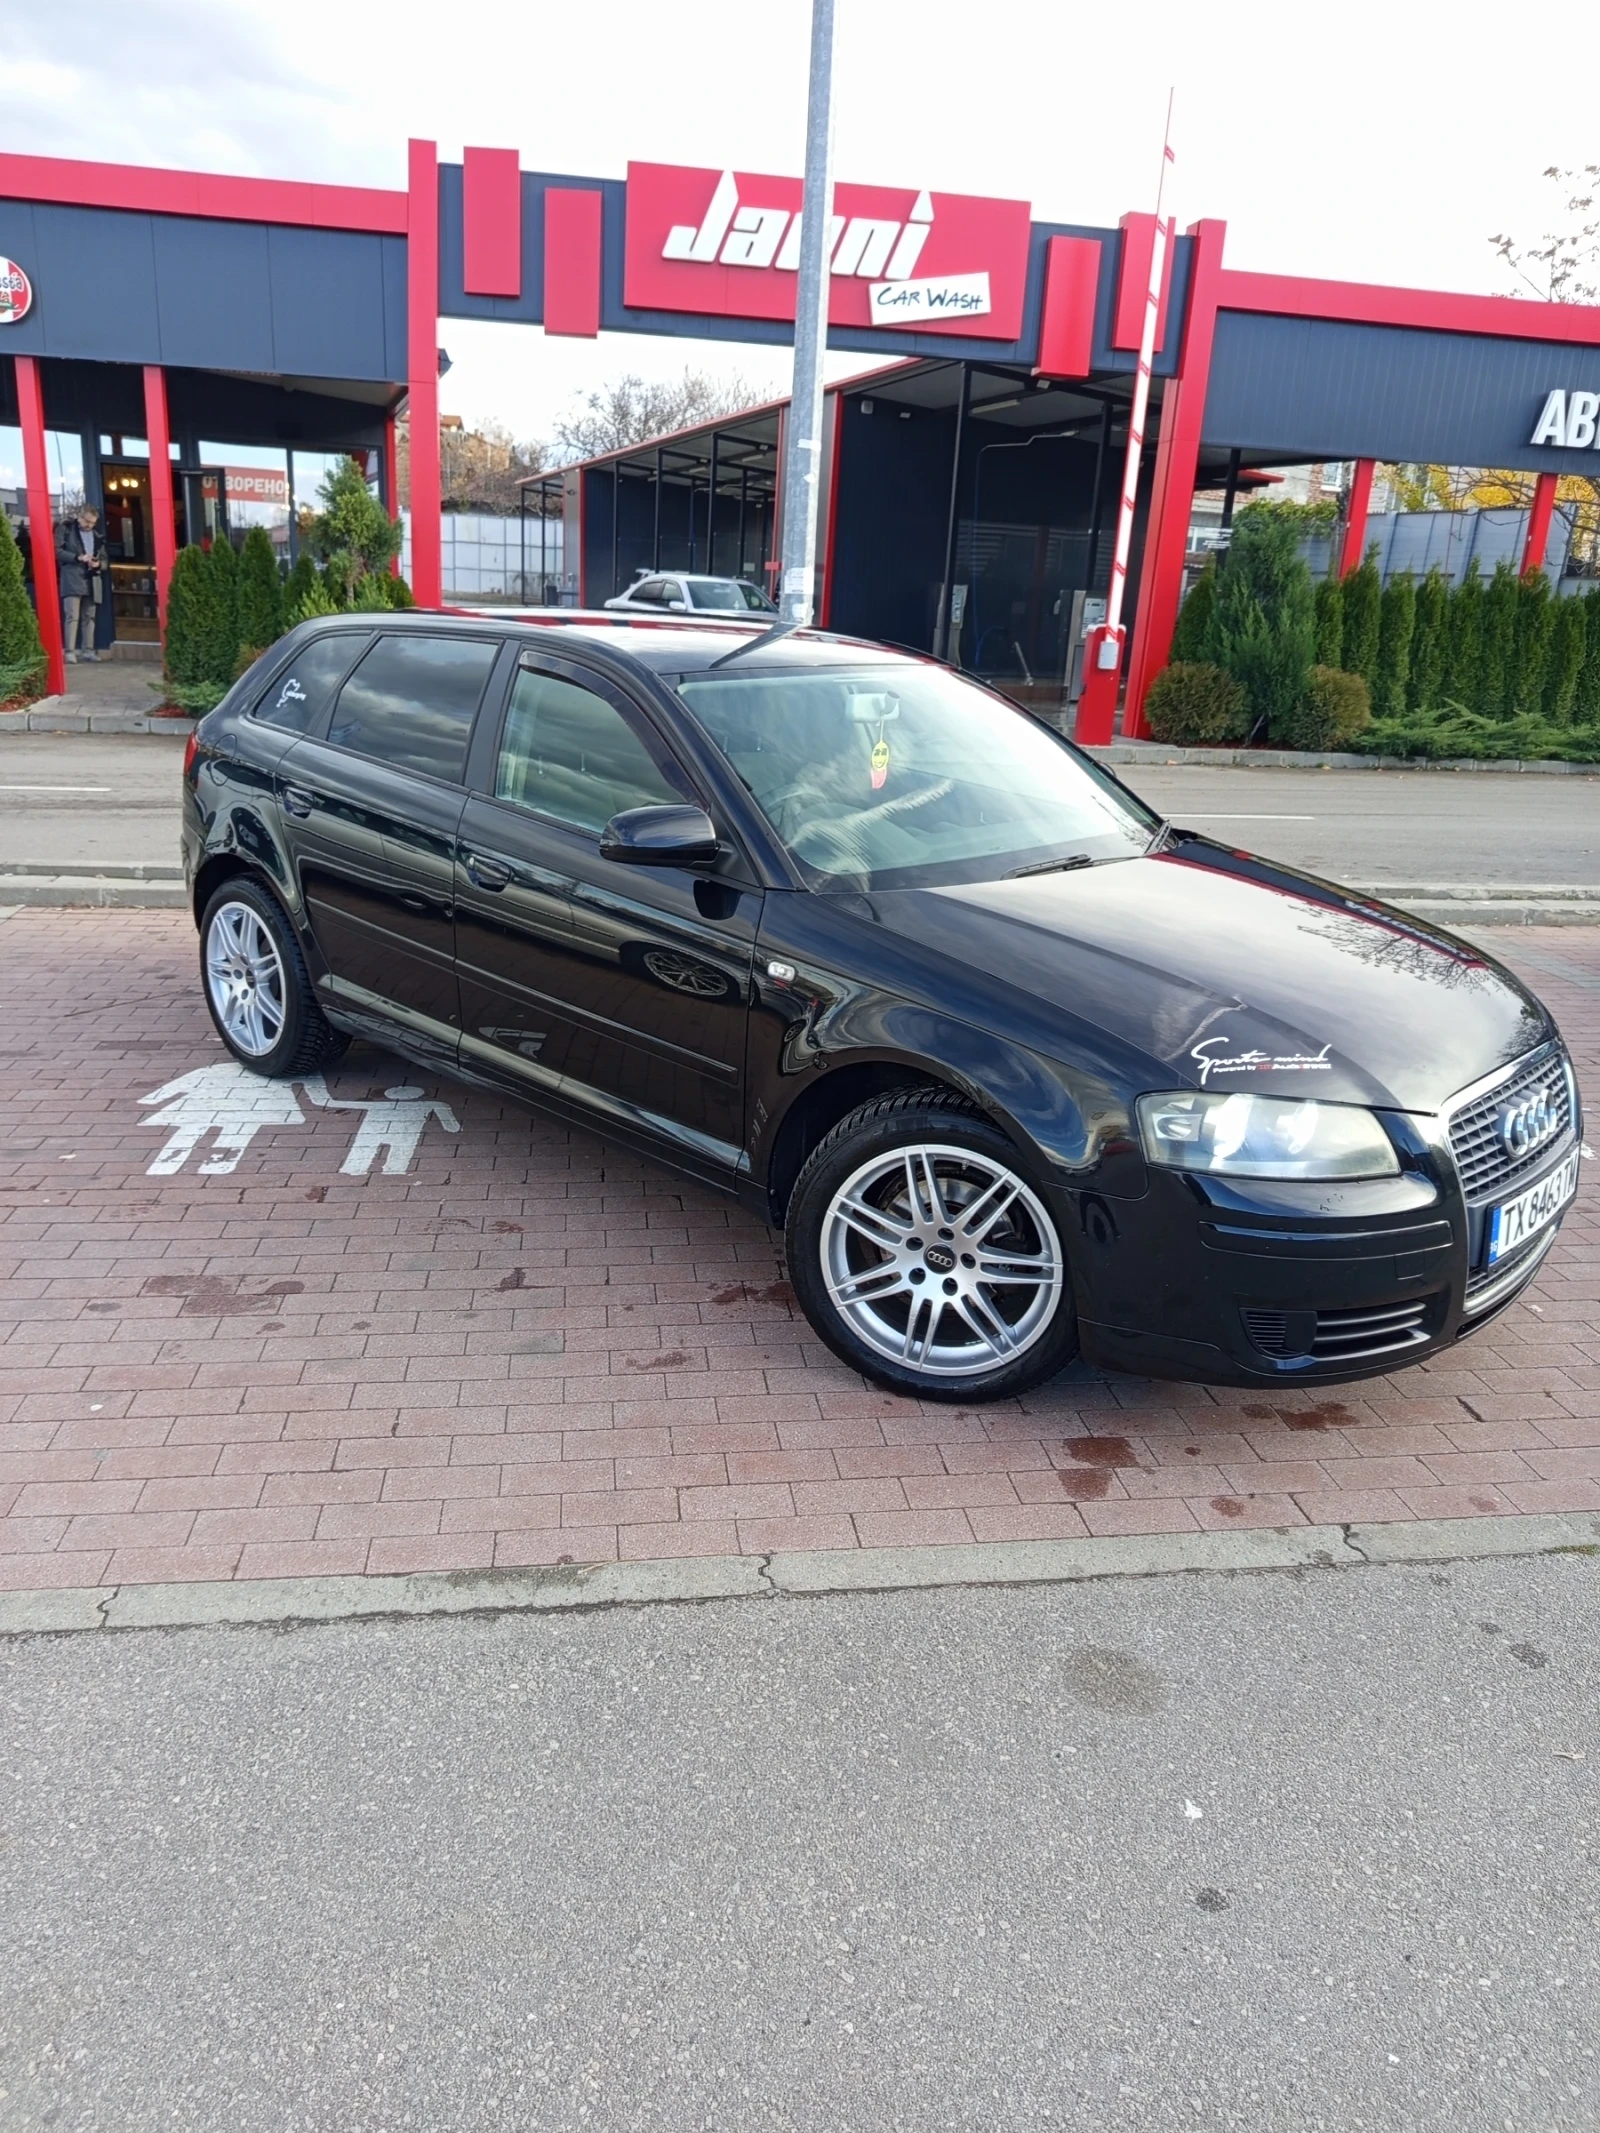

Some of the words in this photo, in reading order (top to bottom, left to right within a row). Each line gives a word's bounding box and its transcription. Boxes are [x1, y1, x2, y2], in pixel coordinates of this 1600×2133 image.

[877, 286, 920, 306] CAR
[927, 287, 983, 310] WASH
[1530, 389, 1600, 450] АВ
